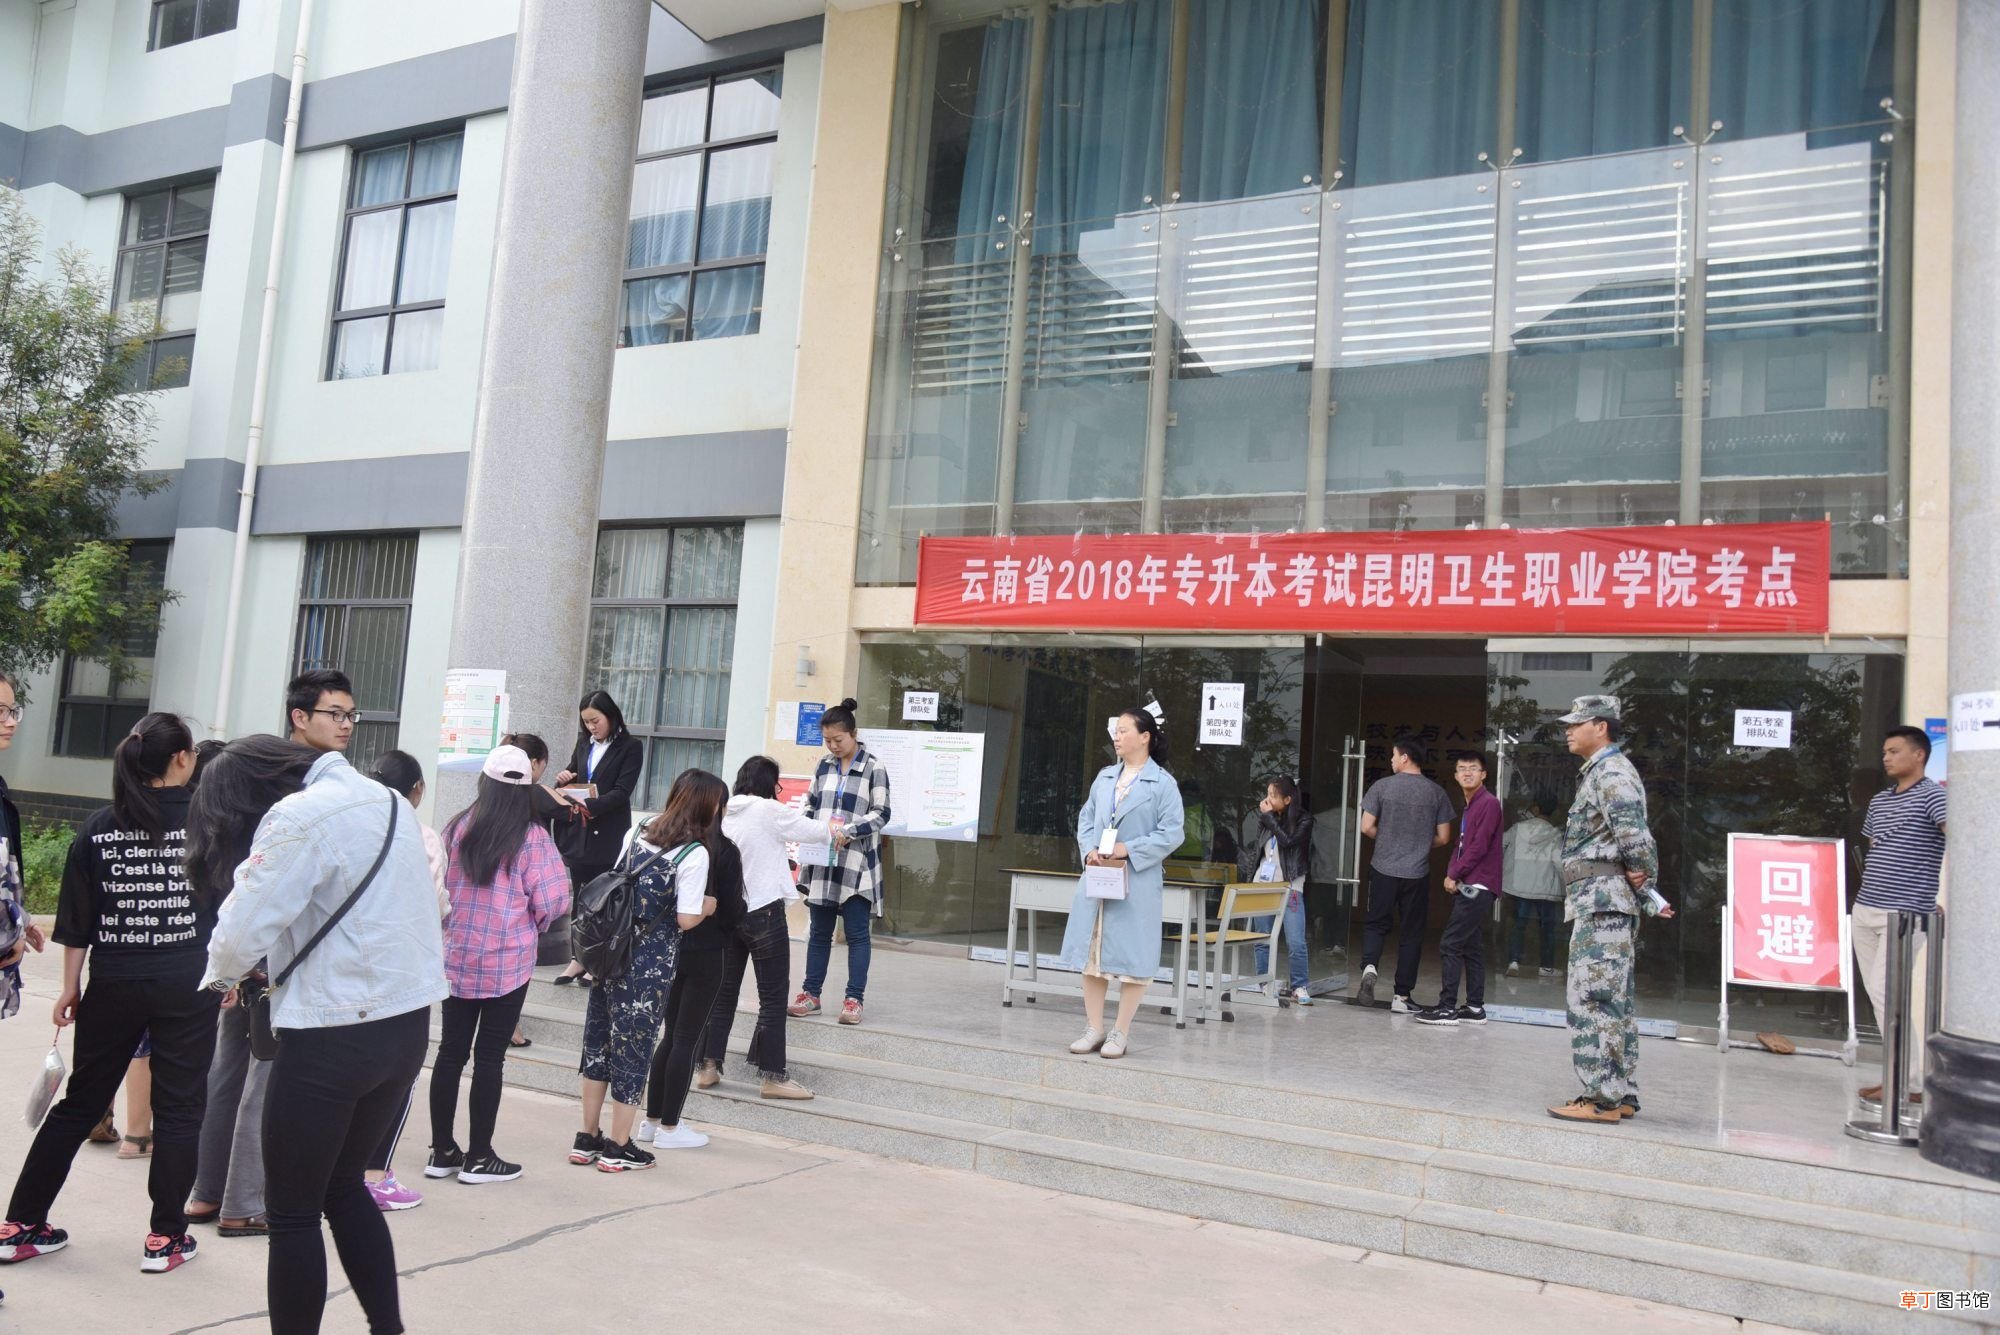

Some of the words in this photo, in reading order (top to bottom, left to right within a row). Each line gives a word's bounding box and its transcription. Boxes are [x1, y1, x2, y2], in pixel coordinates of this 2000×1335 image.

[960, 546, 1799, 609] 云南省2018年专升本考试昆明卫生职业学院考点
[908, 696, 935, 705] 第三考室
[1206, 718, 1238, 728] 第四考室
[1742, 716, 1784, 728] 第五考室
[1209, 728, 1233, 737] 排队处
[1746, 728, 1779, 739] 排队处
[111, 863, 150, 876] C'est
[152, 862, 166, 875] là
[117, 899, 135, 909] en
[138, 895, 191, 911] pontilé
[125, 915, 160, 926] este
[168, 912, 196, 925] réel
[1757, 861, 1814, 964] 回避
[98, 930, 118, 943] Un
[121, 930, 150, 943] réel
